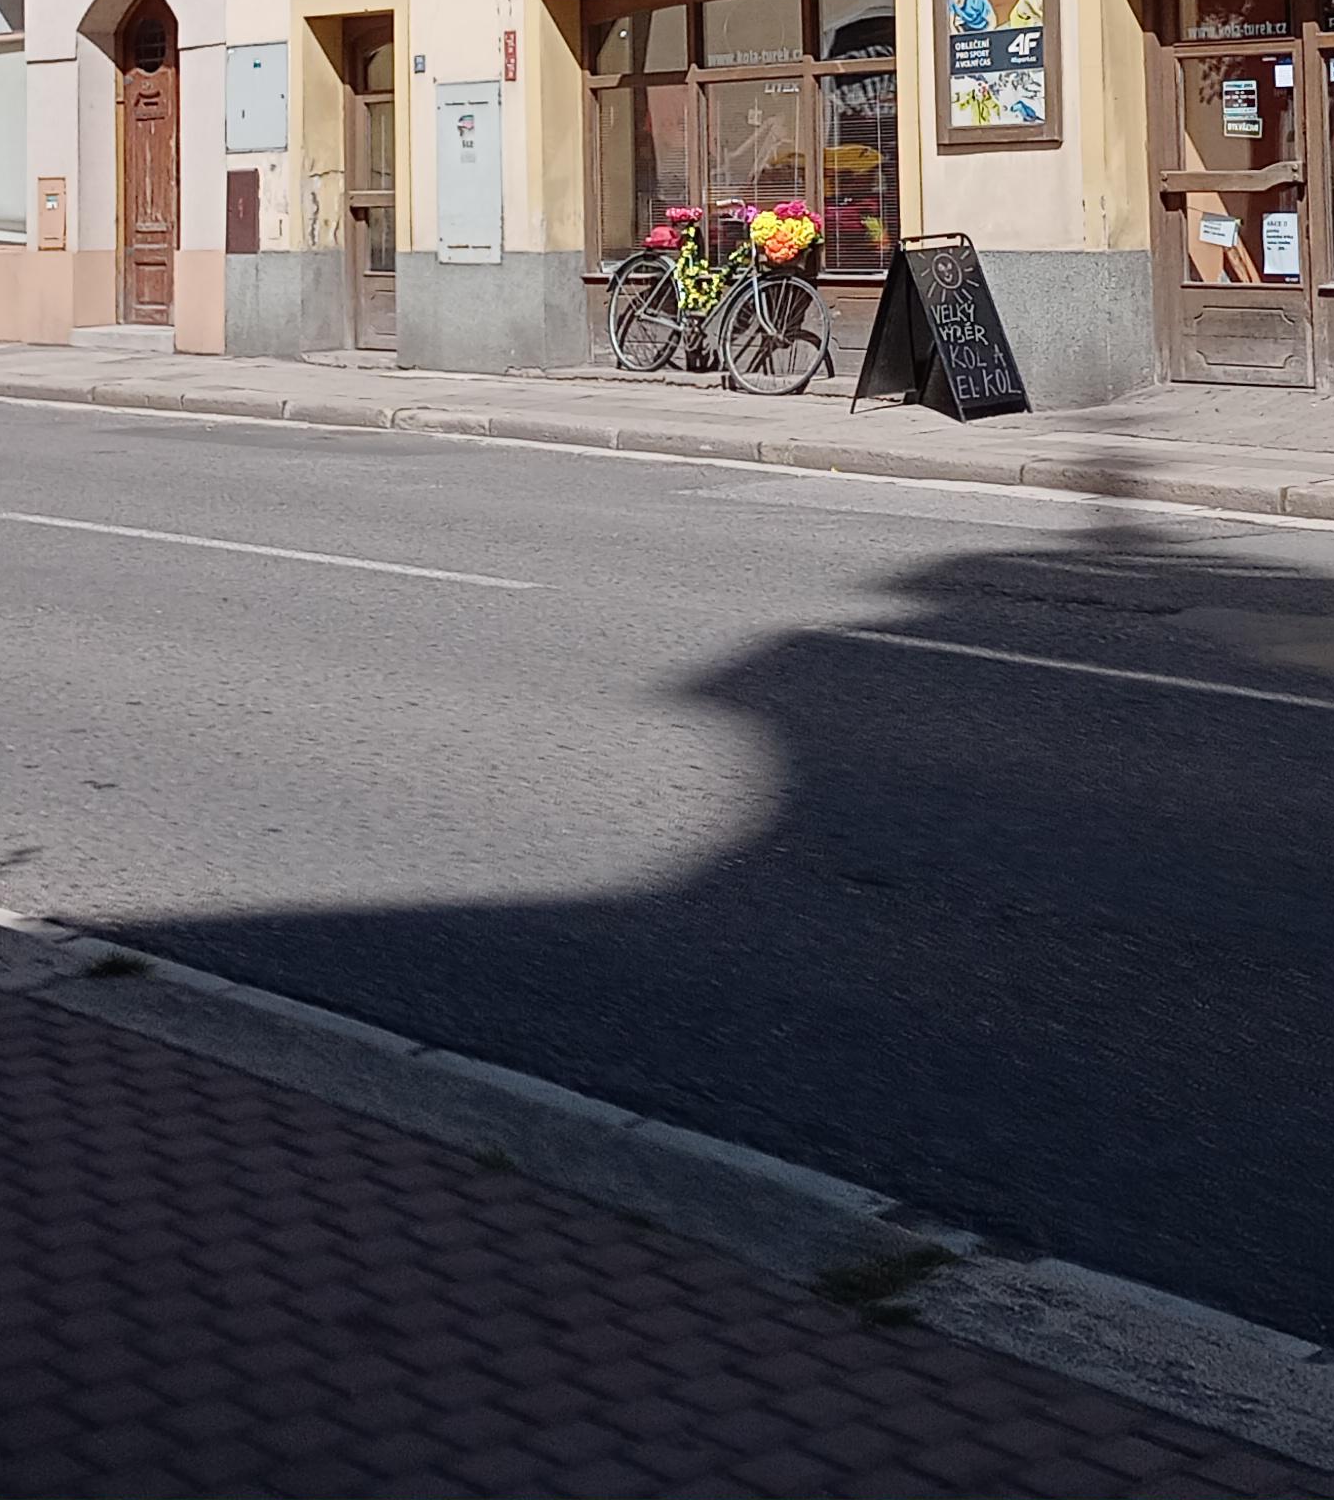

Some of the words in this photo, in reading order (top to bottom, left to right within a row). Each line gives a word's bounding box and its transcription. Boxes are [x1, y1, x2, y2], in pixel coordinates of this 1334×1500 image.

[1187, 19, 1288, 39] www.kola-turek.cz
[954, 38, 990, 51] OBLEČENÍ
[955, 51, 969, 60] PRO
[969, 49, 990, 59] SPORT
[1007, 31, 1041, 56] 4F
[979, 57, 992, 67] ČAS
[930, 300, 975, 324] VELKÝ
[939, 321, 989, 346] VÝBĚR
[949, 344, 987, 369] KOL
[993, 343, 1007, 367] A
